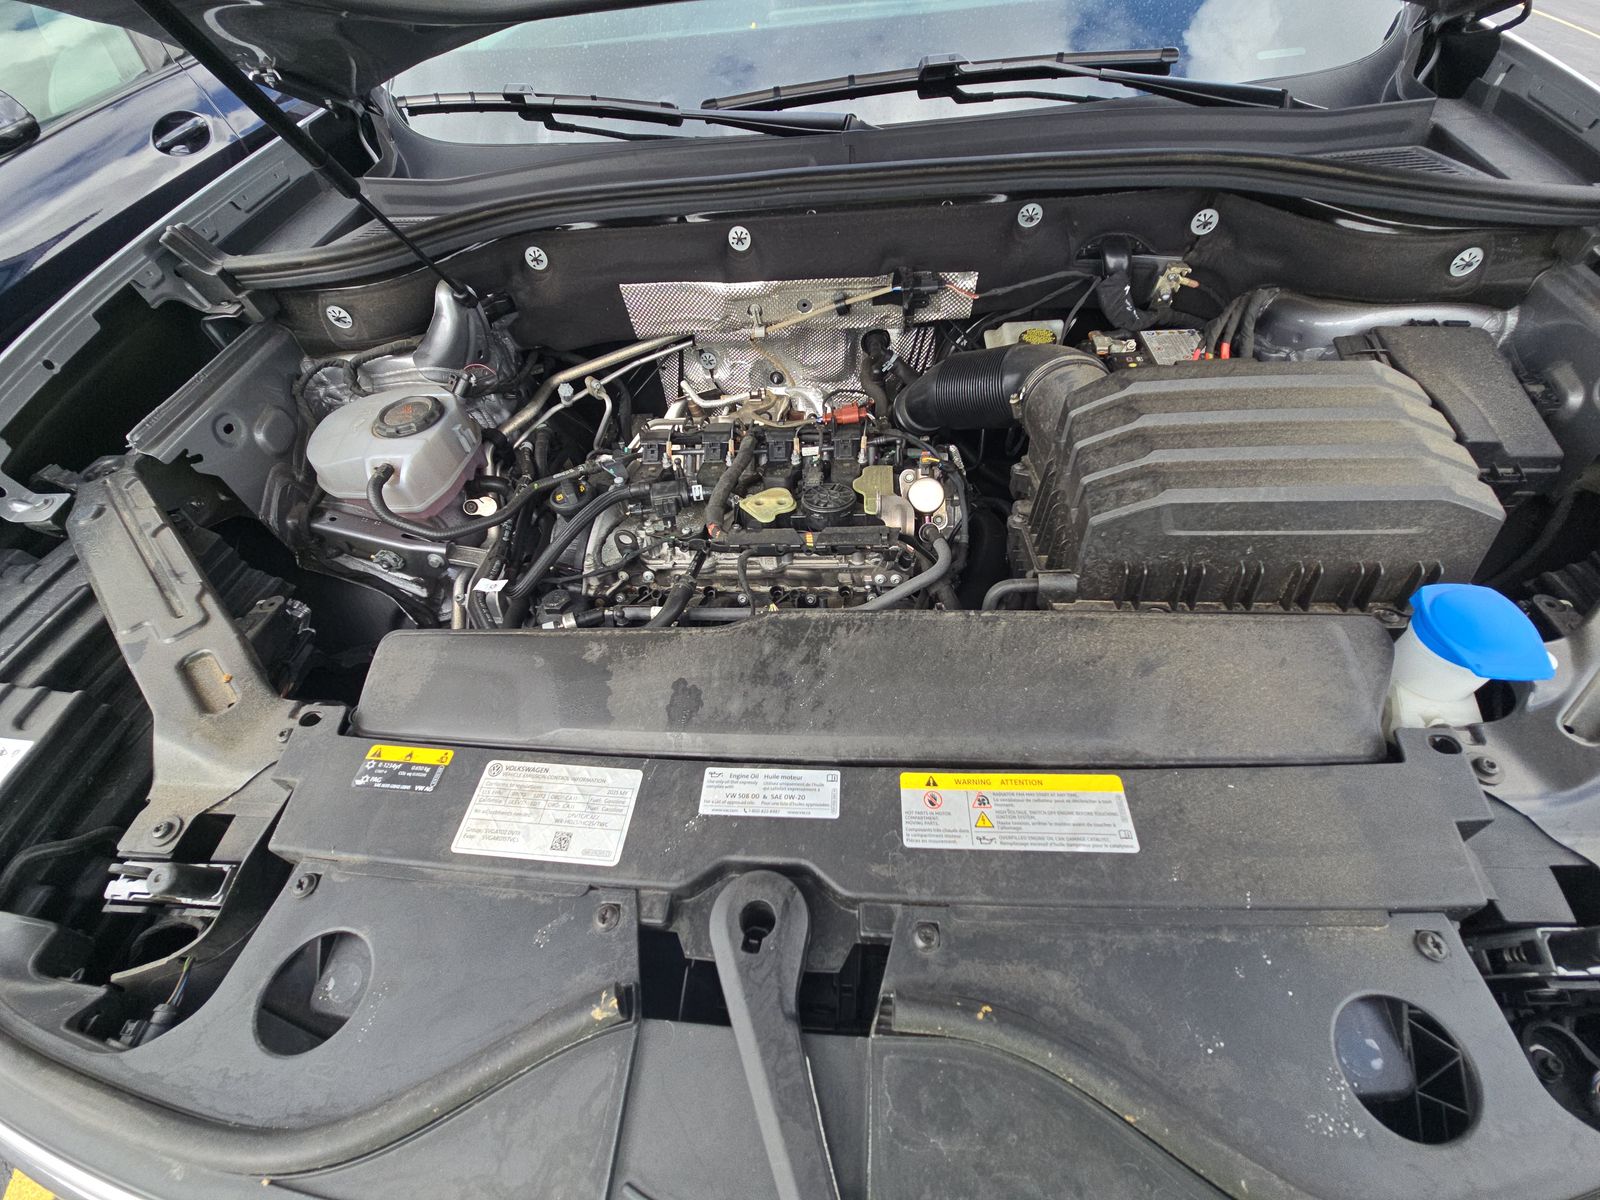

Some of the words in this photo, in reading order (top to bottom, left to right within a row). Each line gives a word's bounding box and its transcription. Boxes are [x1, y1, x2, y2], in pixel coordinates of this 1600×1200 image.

[505, 765, 550, 774] VOLKSWAGEN
[954, 778, 992, 786] WARNING
[1000, 778, 1043, 787] ATTENTION
